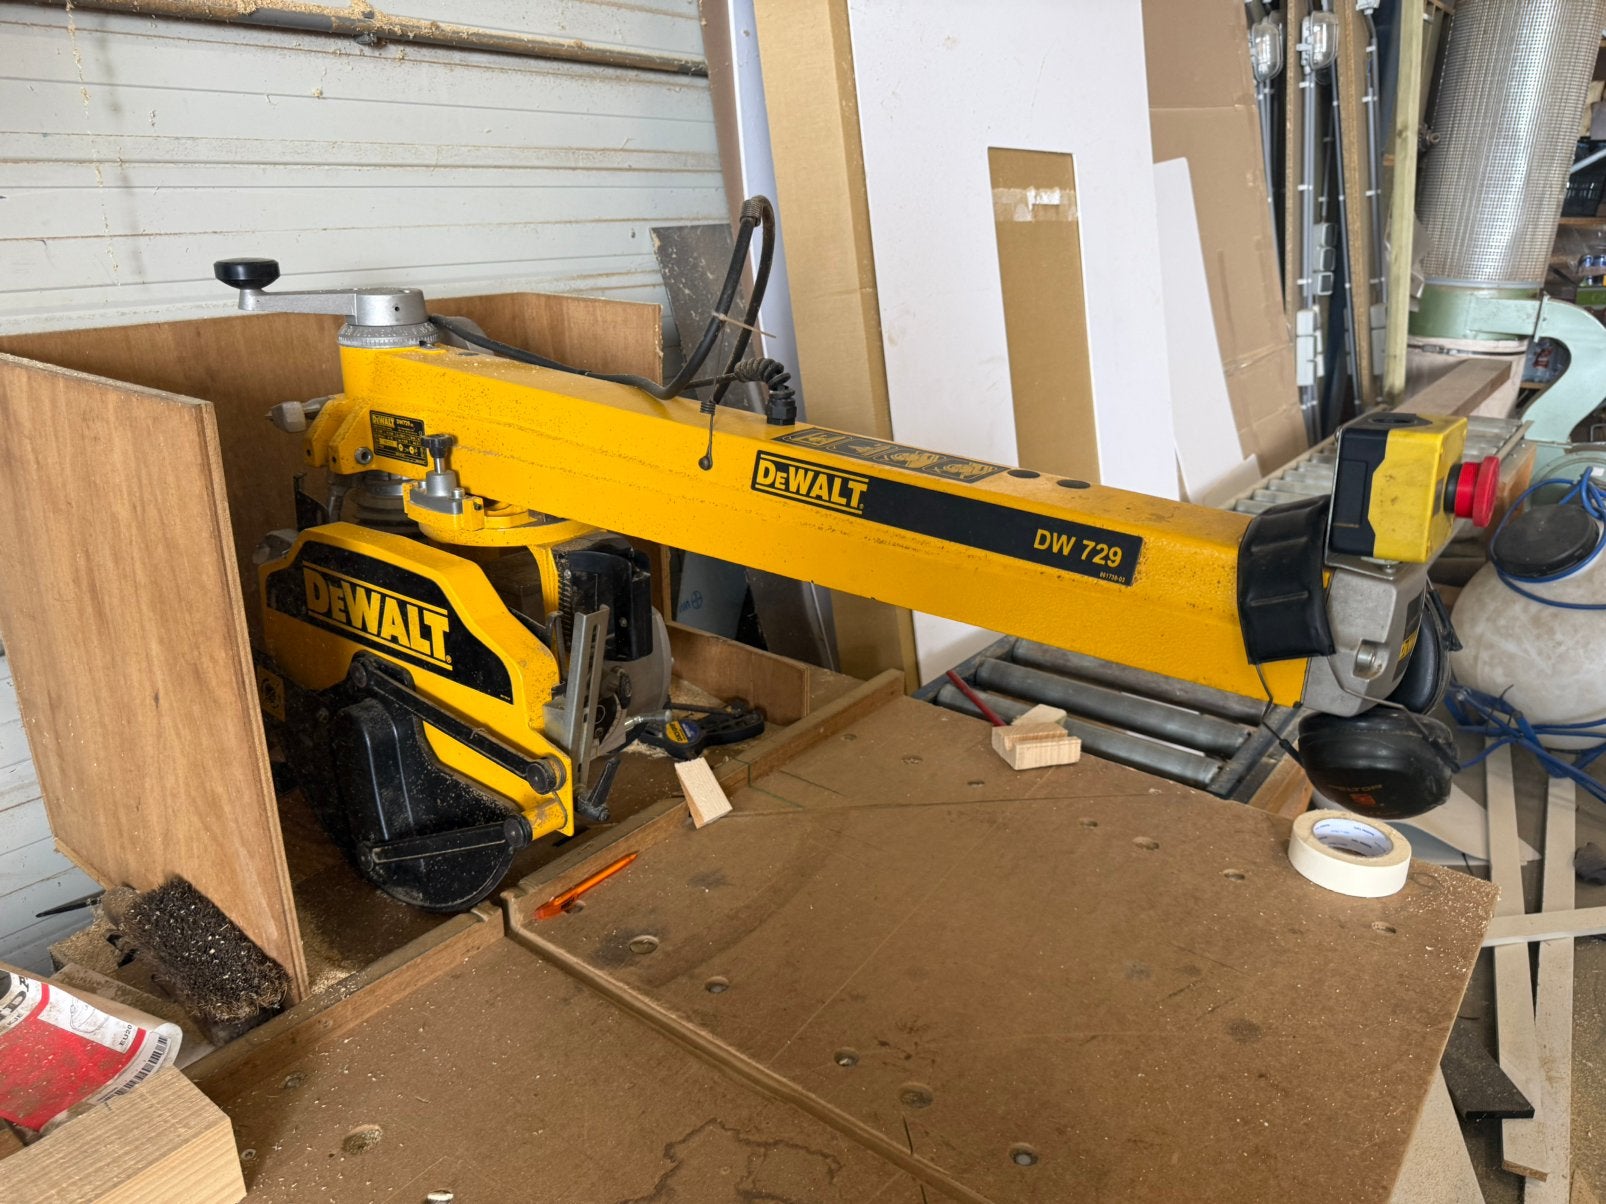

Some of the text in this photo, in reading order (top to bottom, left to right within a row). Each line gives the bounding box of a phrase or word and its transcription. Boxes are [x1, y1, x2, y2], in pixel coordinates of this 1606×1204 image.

[757, 459, 868, 508] DeWALT
[1033, 528, 1122, 568] DW 729
[303, 567, 449, 662] DeWALT
